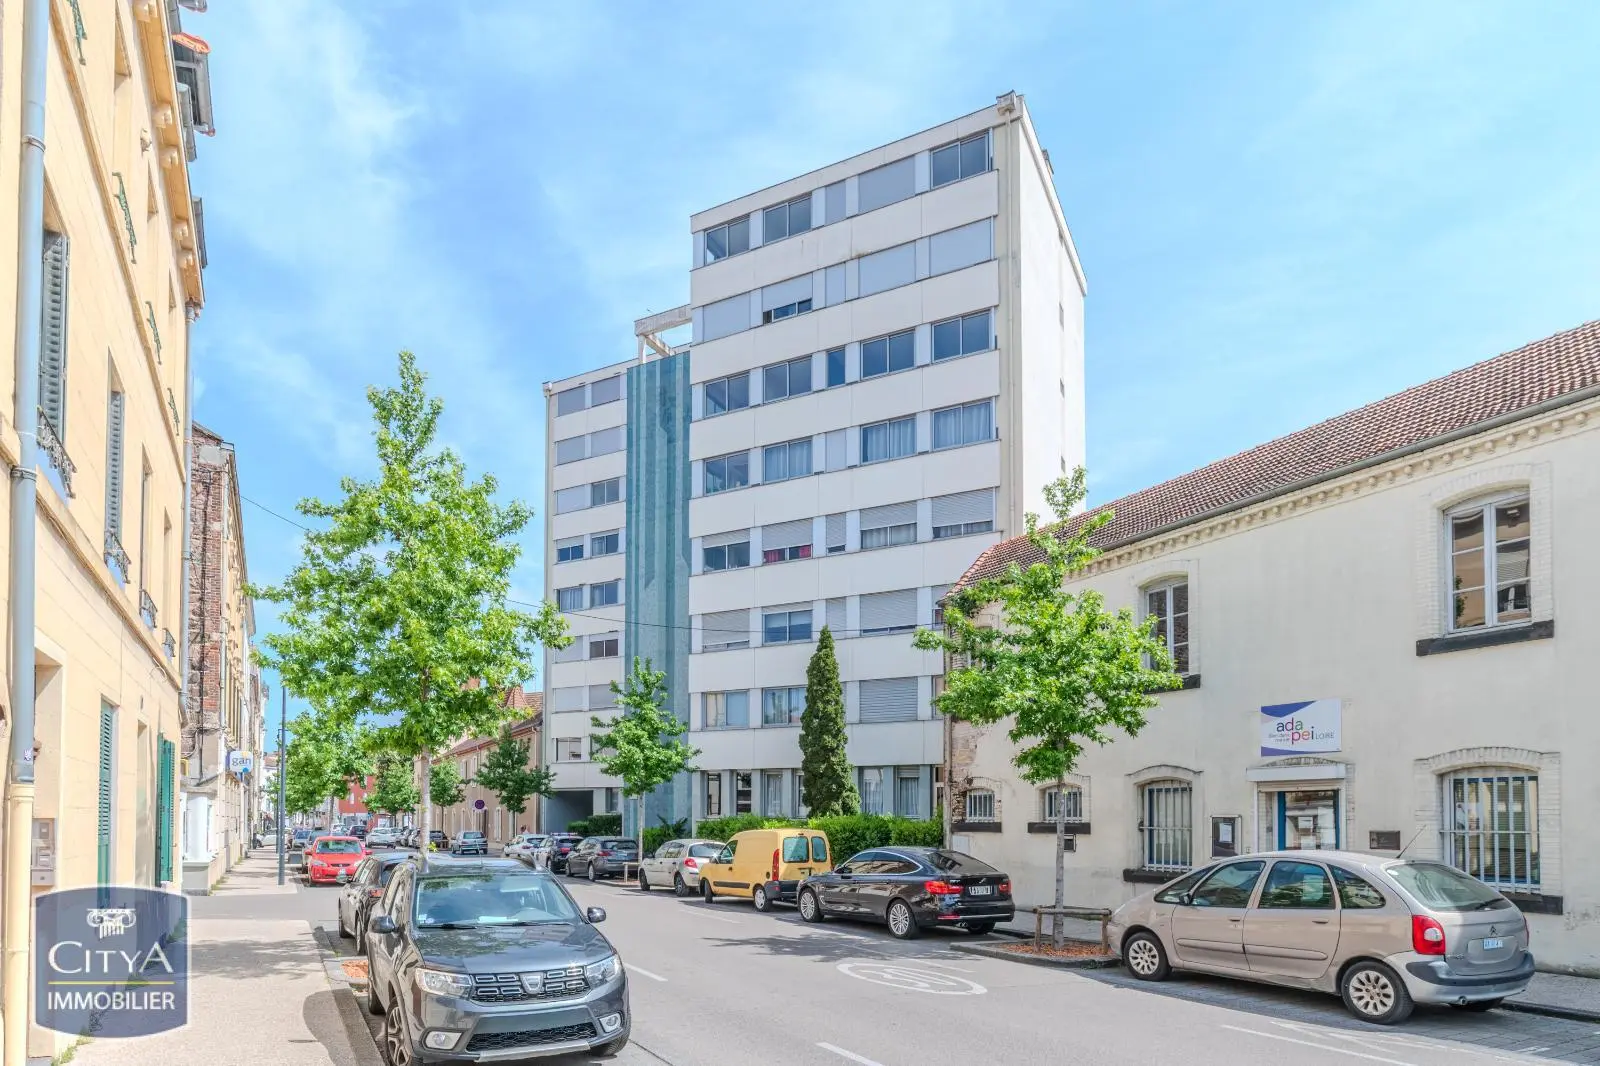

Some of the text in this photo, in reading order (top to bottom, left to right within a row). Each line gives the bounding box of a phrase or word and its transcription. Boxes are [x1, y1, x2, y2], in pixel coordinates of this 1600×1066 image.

[1276, 717, 1303, 732] ada
[1291, 726, 1314, 745] pei
[232, 757, 251, 767] gan
